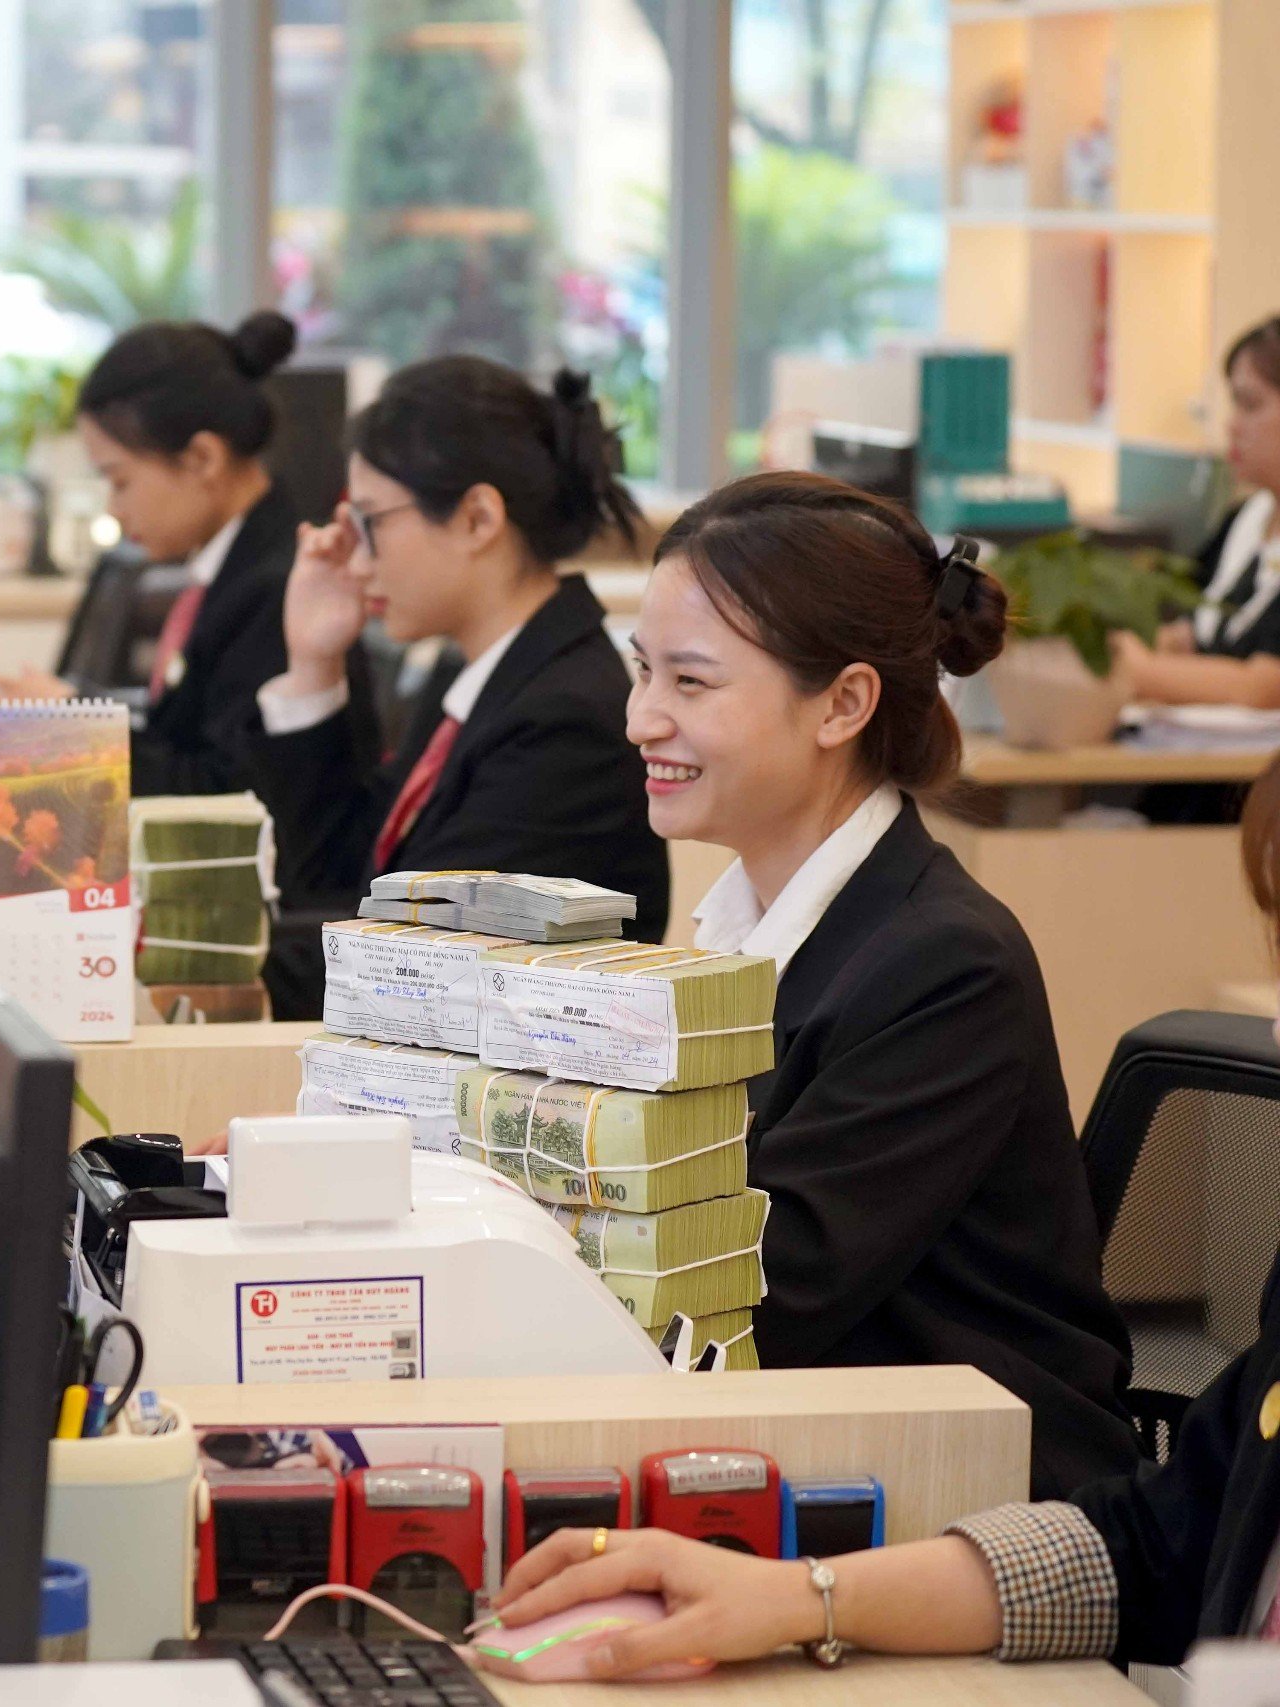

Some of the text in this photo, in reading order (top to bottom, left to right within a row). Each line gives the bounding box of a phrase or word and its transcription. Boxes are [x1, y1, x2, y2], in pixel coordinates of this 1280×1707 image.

[84, 888, 115, 908] 04
[79, 956, 116, 978] 30
[396, 967, 420, 978] 200.000
[80, 1011, 114, 1022] 2024
[504, 1090, 520, 1099] NGÂN
[520, 1093, 539, 1102] HÀN
[570, 1100, 587, 1109] VIỆT
[562, 1179, 627, 1202] 1000
